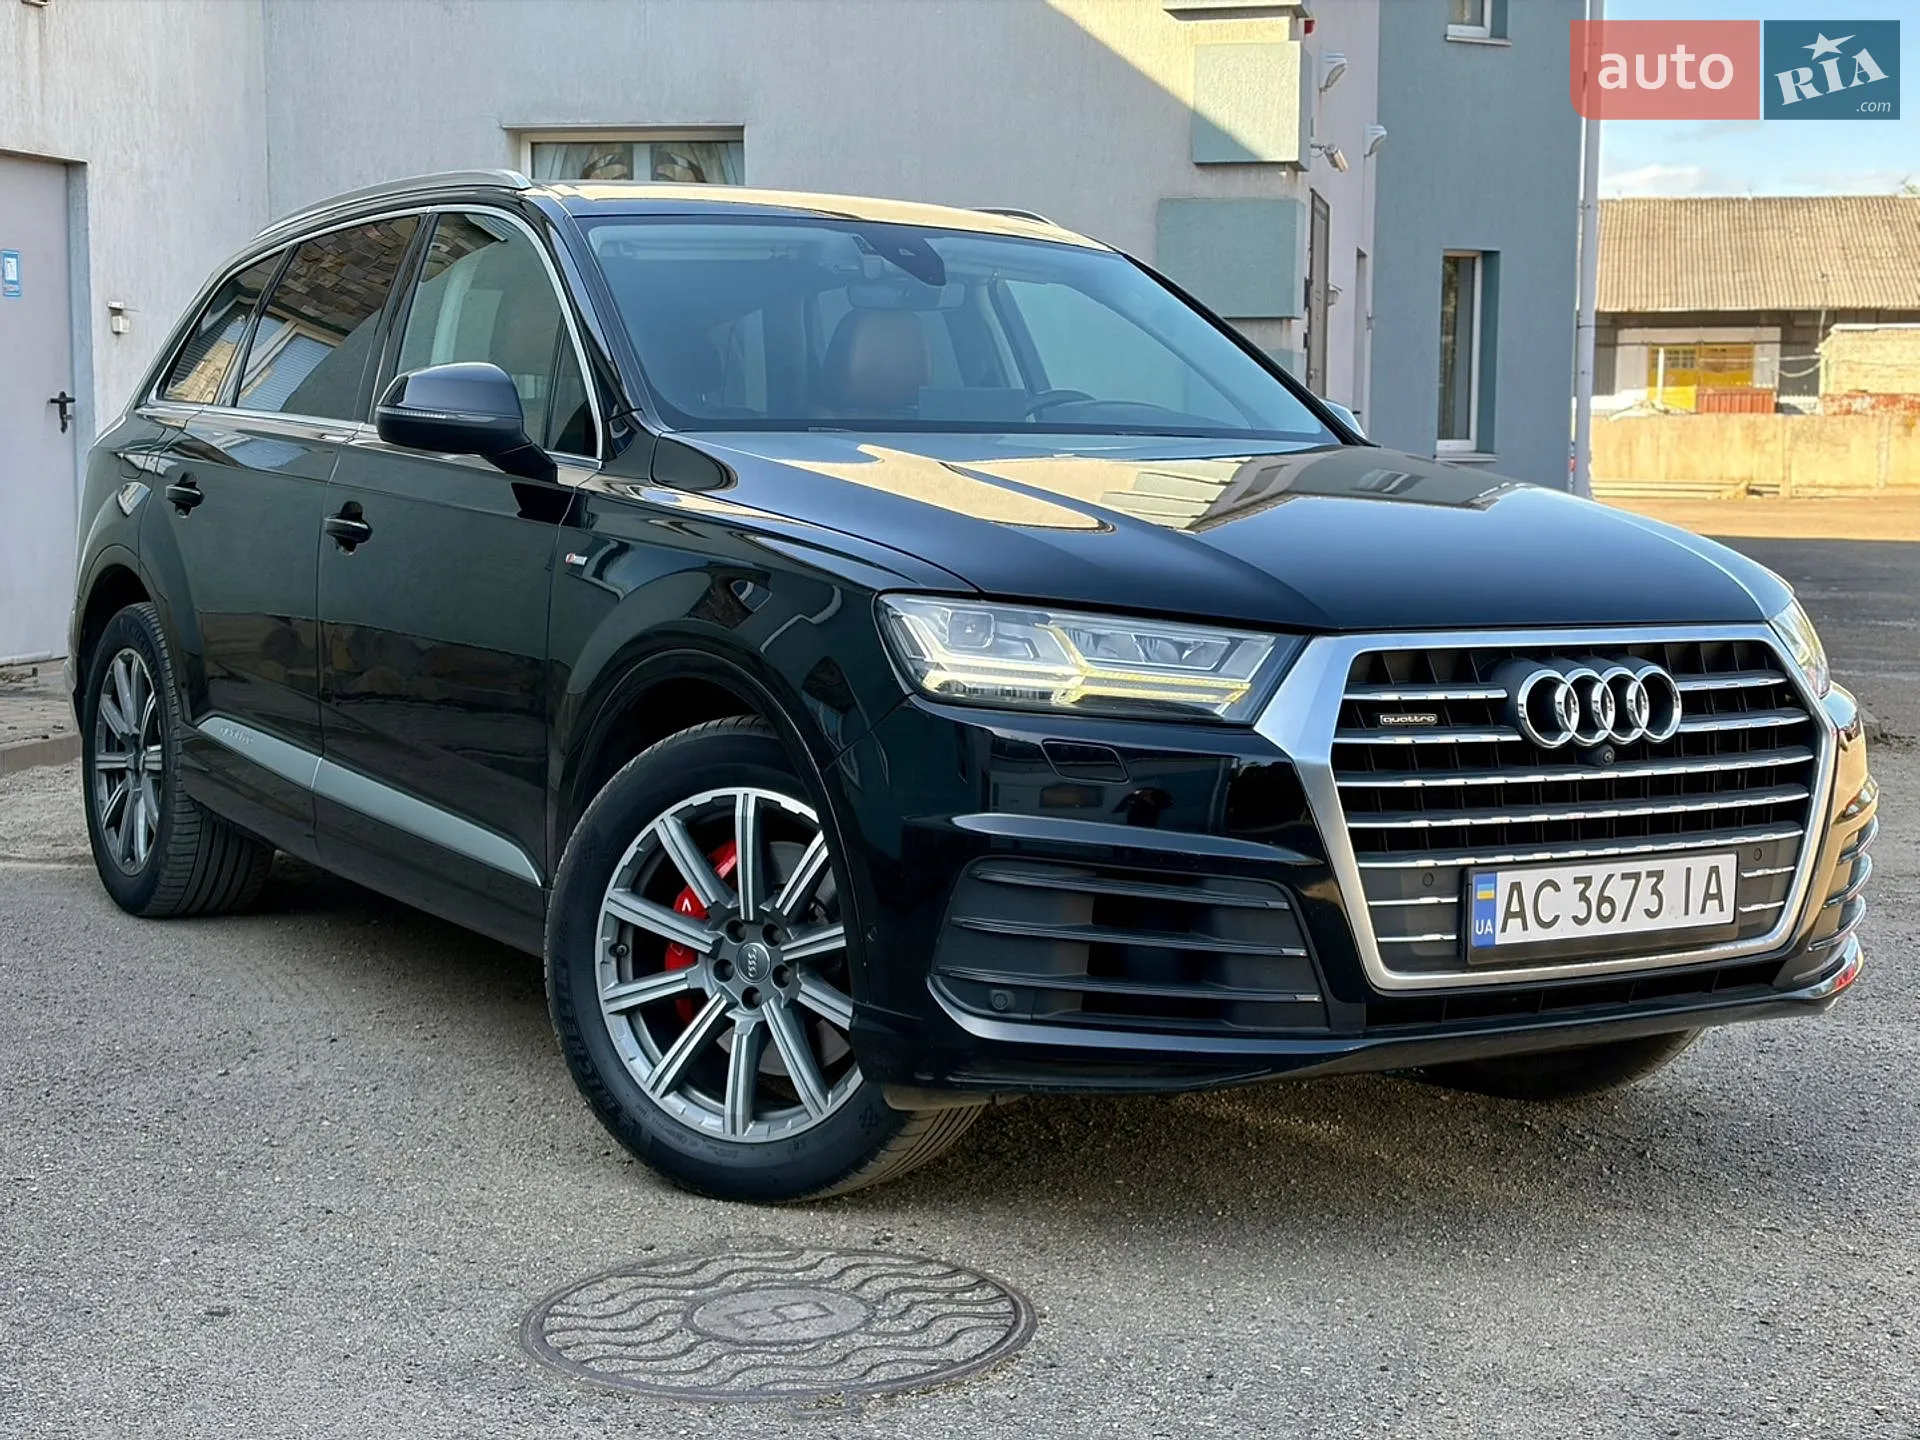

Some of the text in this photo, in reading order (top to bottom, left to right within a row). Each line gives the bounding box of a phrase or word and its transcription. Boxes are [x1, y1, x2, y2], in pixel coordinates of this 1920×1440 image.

[1383, 716, 1435, 725] quattro
[1500, 864, 1726, 934] AC 3673 IA
[1476, 920, 1494, 936] UA
